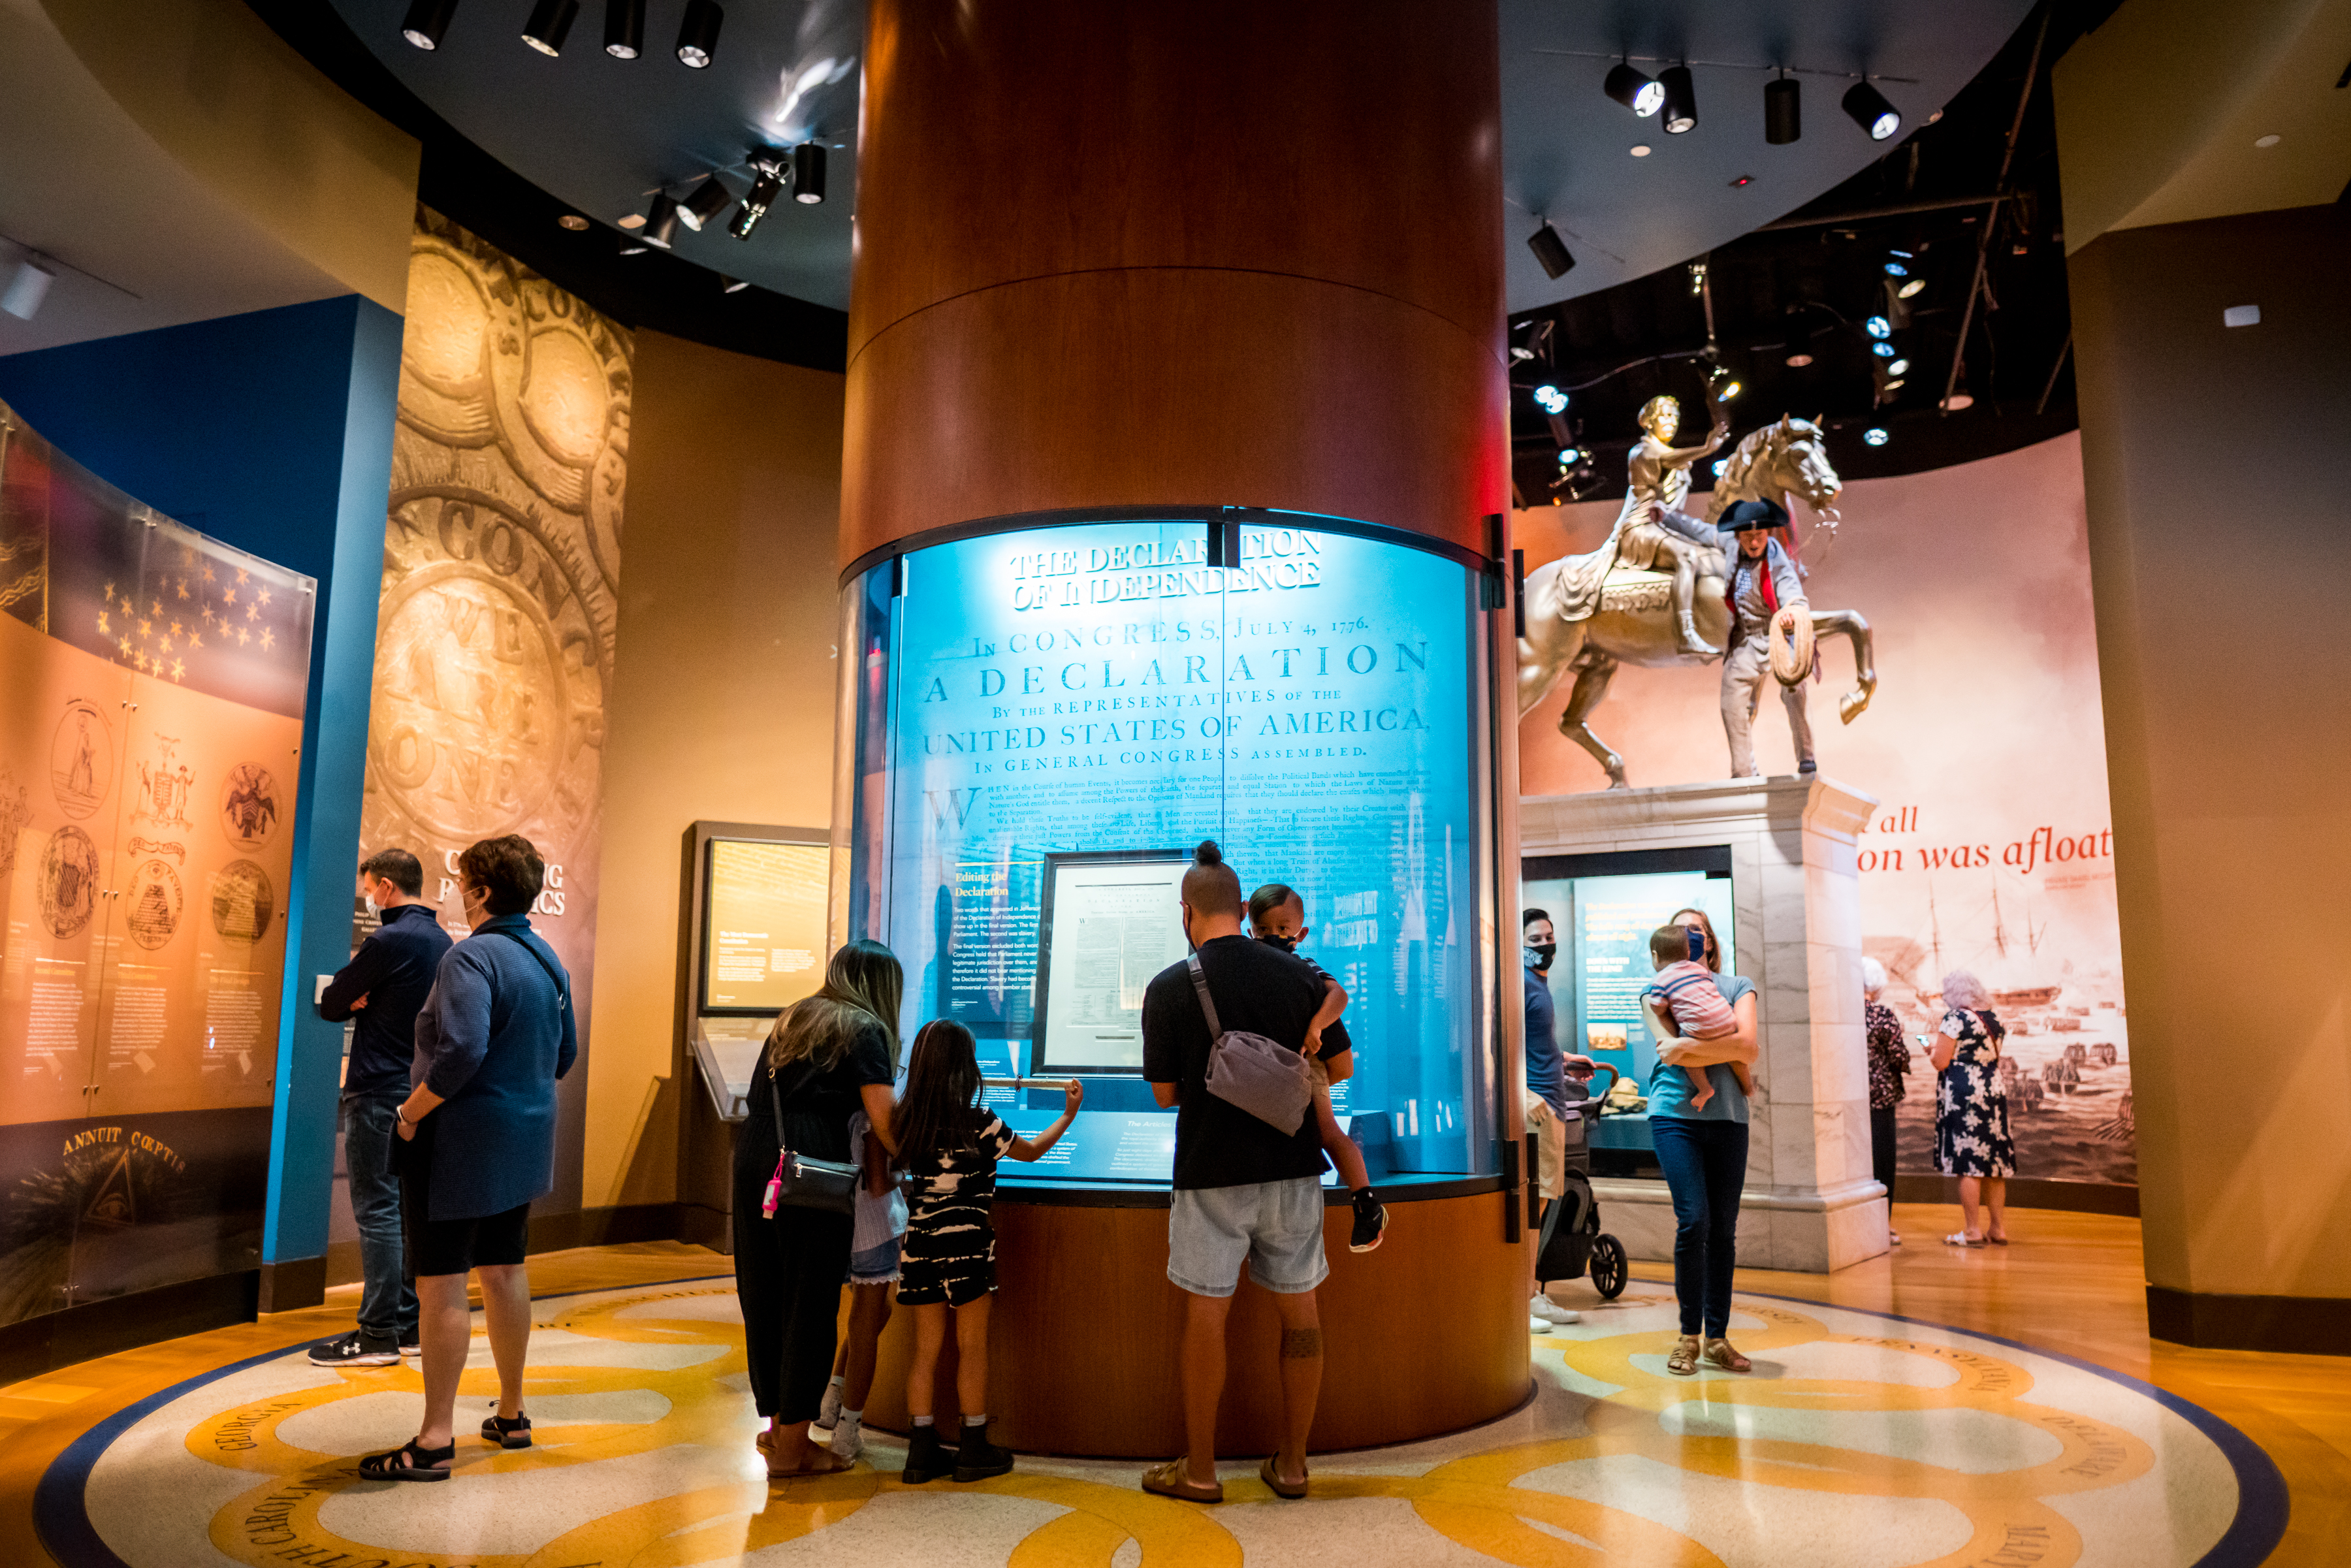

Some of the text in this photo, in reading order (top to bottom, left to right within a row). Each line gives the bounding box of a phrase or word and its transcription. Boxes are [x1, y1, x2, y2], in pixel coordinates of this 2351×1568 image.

[1010, 551, 1076, 579] THE
[1010, 560, 1321, 611] OF INDEPENDENCE
[1009, 619, 1220, 653] CONGRESS,
[1303, 624, 1316, 636] 4,
[1332, 616, 1368, 633] 1776.
[925, 641, 1428, 703] A DECLARATION
[1053, 690, 1275, 714] REPRESENTATIVES
[1285, 692, 1302, 700] OF
[1313, 690, 1341, 699] THE
[924, 708, 1430, 755] UNITED STATES OF AMERICA,
[1005, 754, 1108, 772] GENERAL
[1120, 747, 1239, 764] CONGRESS
[1252, 747, 1366, 759] ASSEMBLED.
[1261, 790, 1274, 799] they
[1880, 806, 1918, 833] all
[1918, 844, 1990, 869] was
[955, 871, 1007, 882] Editing the
[955, 887, 1008, 897] Declaration
[63, 1127, 121, 1156] ANNUIT
[215, 1403, 302, 1451] GEORGIA
